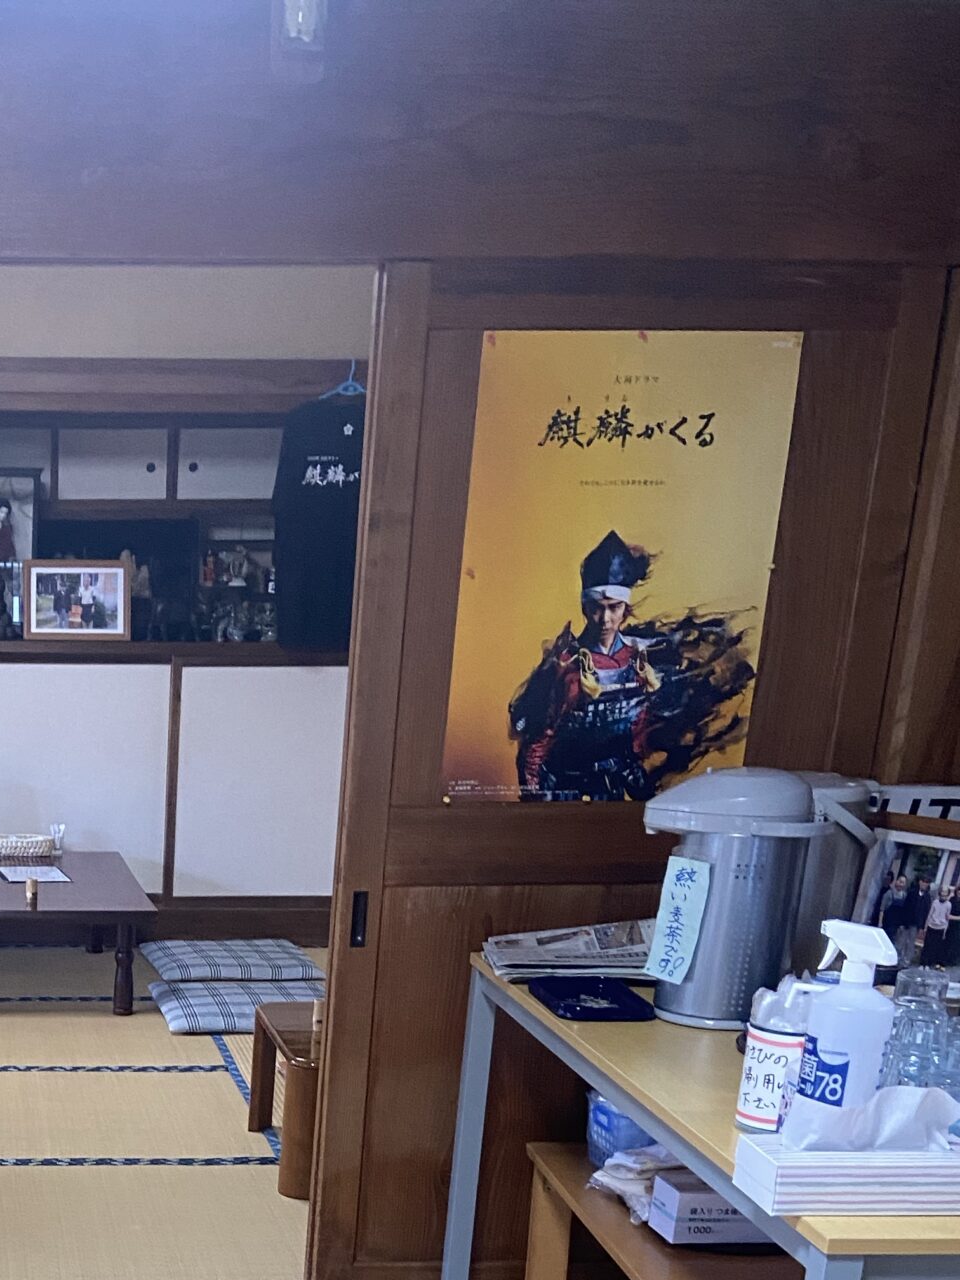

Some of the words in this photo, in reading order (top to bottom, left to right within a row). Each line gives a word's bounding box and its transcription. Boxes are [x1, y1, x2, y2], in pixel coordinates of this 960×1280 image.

[538, 404, 716, 450] 麒麟がくる
[814, 1070, 843, 1101] 78
[742, 1092, 776, 1110] 下さい
[688, 1225, 712, 1236] 1000
